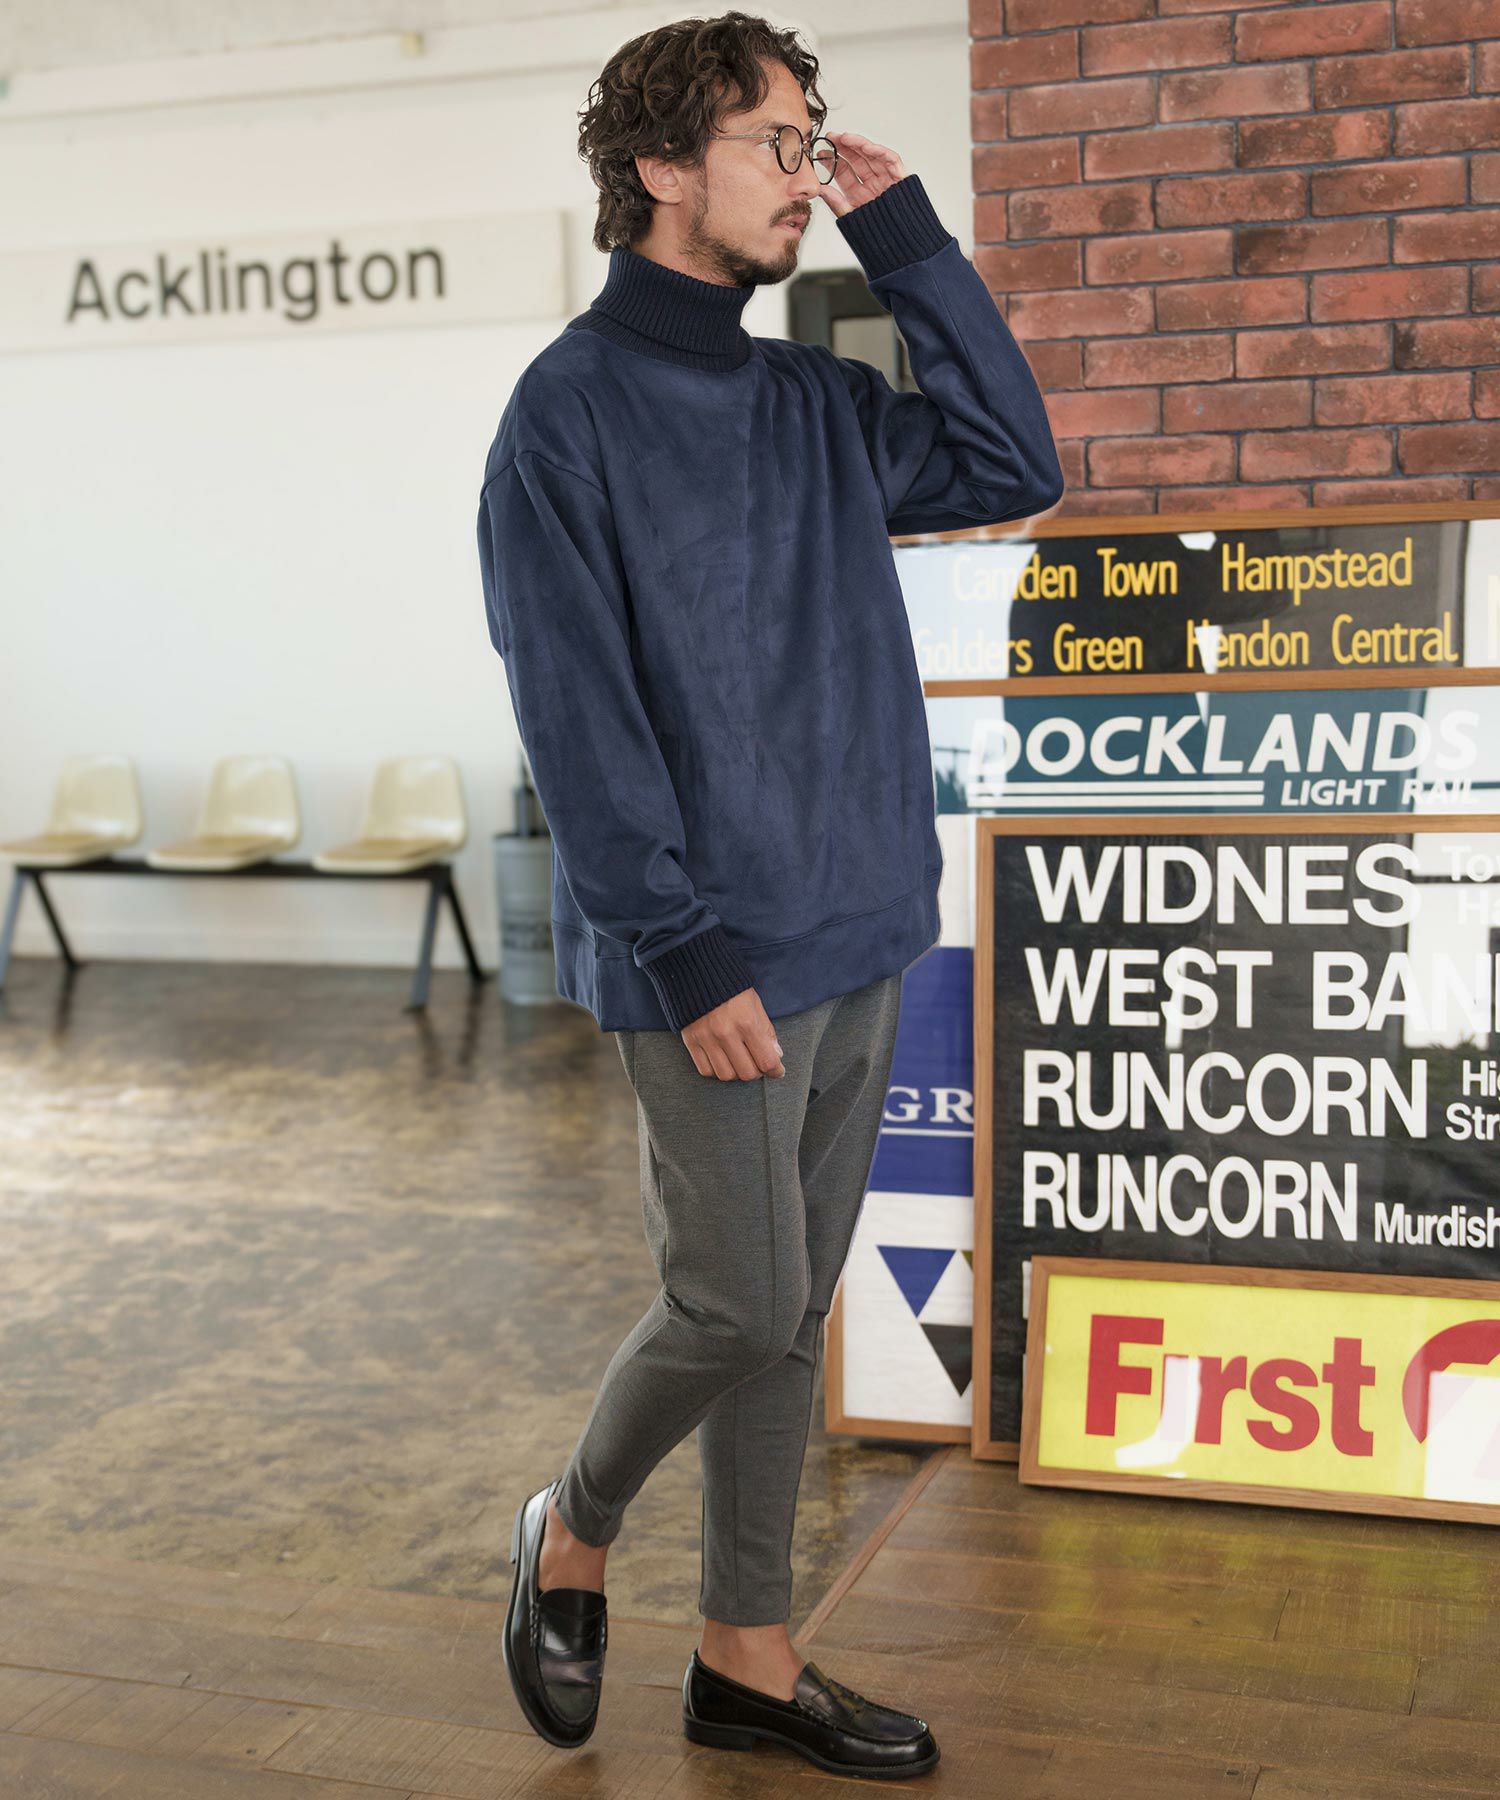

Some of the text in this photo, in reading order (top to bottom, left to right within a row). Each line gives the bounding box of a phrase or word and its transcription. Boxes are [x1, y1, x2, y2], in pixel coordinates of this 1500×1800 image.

[66, 240, 446, 322] Acklington
[1097, 547, 1178, 596] Town
[1222, 537, 1413, 605] Hampstead
[1053, 622, 1143, 672] Green
[1186, 618, 1309, 668] Hendon
[1332, 611, 1458, 664] Central
[967, 710, 1480, 776] DOCKLANDS
[1281, 778, 1479, 806] LIGHT RAIL
[1024, 843, 1422, 927] WIDNES
[1441, 845, 1500, 882] To
[1024, 947, 1500, 1033] WEST BAN
[1023, 1049, 1428, 1139] RUNCORN
[1463, 1060, 1500, 1101] Hi
[1023, 1150, 1359, 1242] RUNCORN
[1085, 1314, 1376, 1457] First
